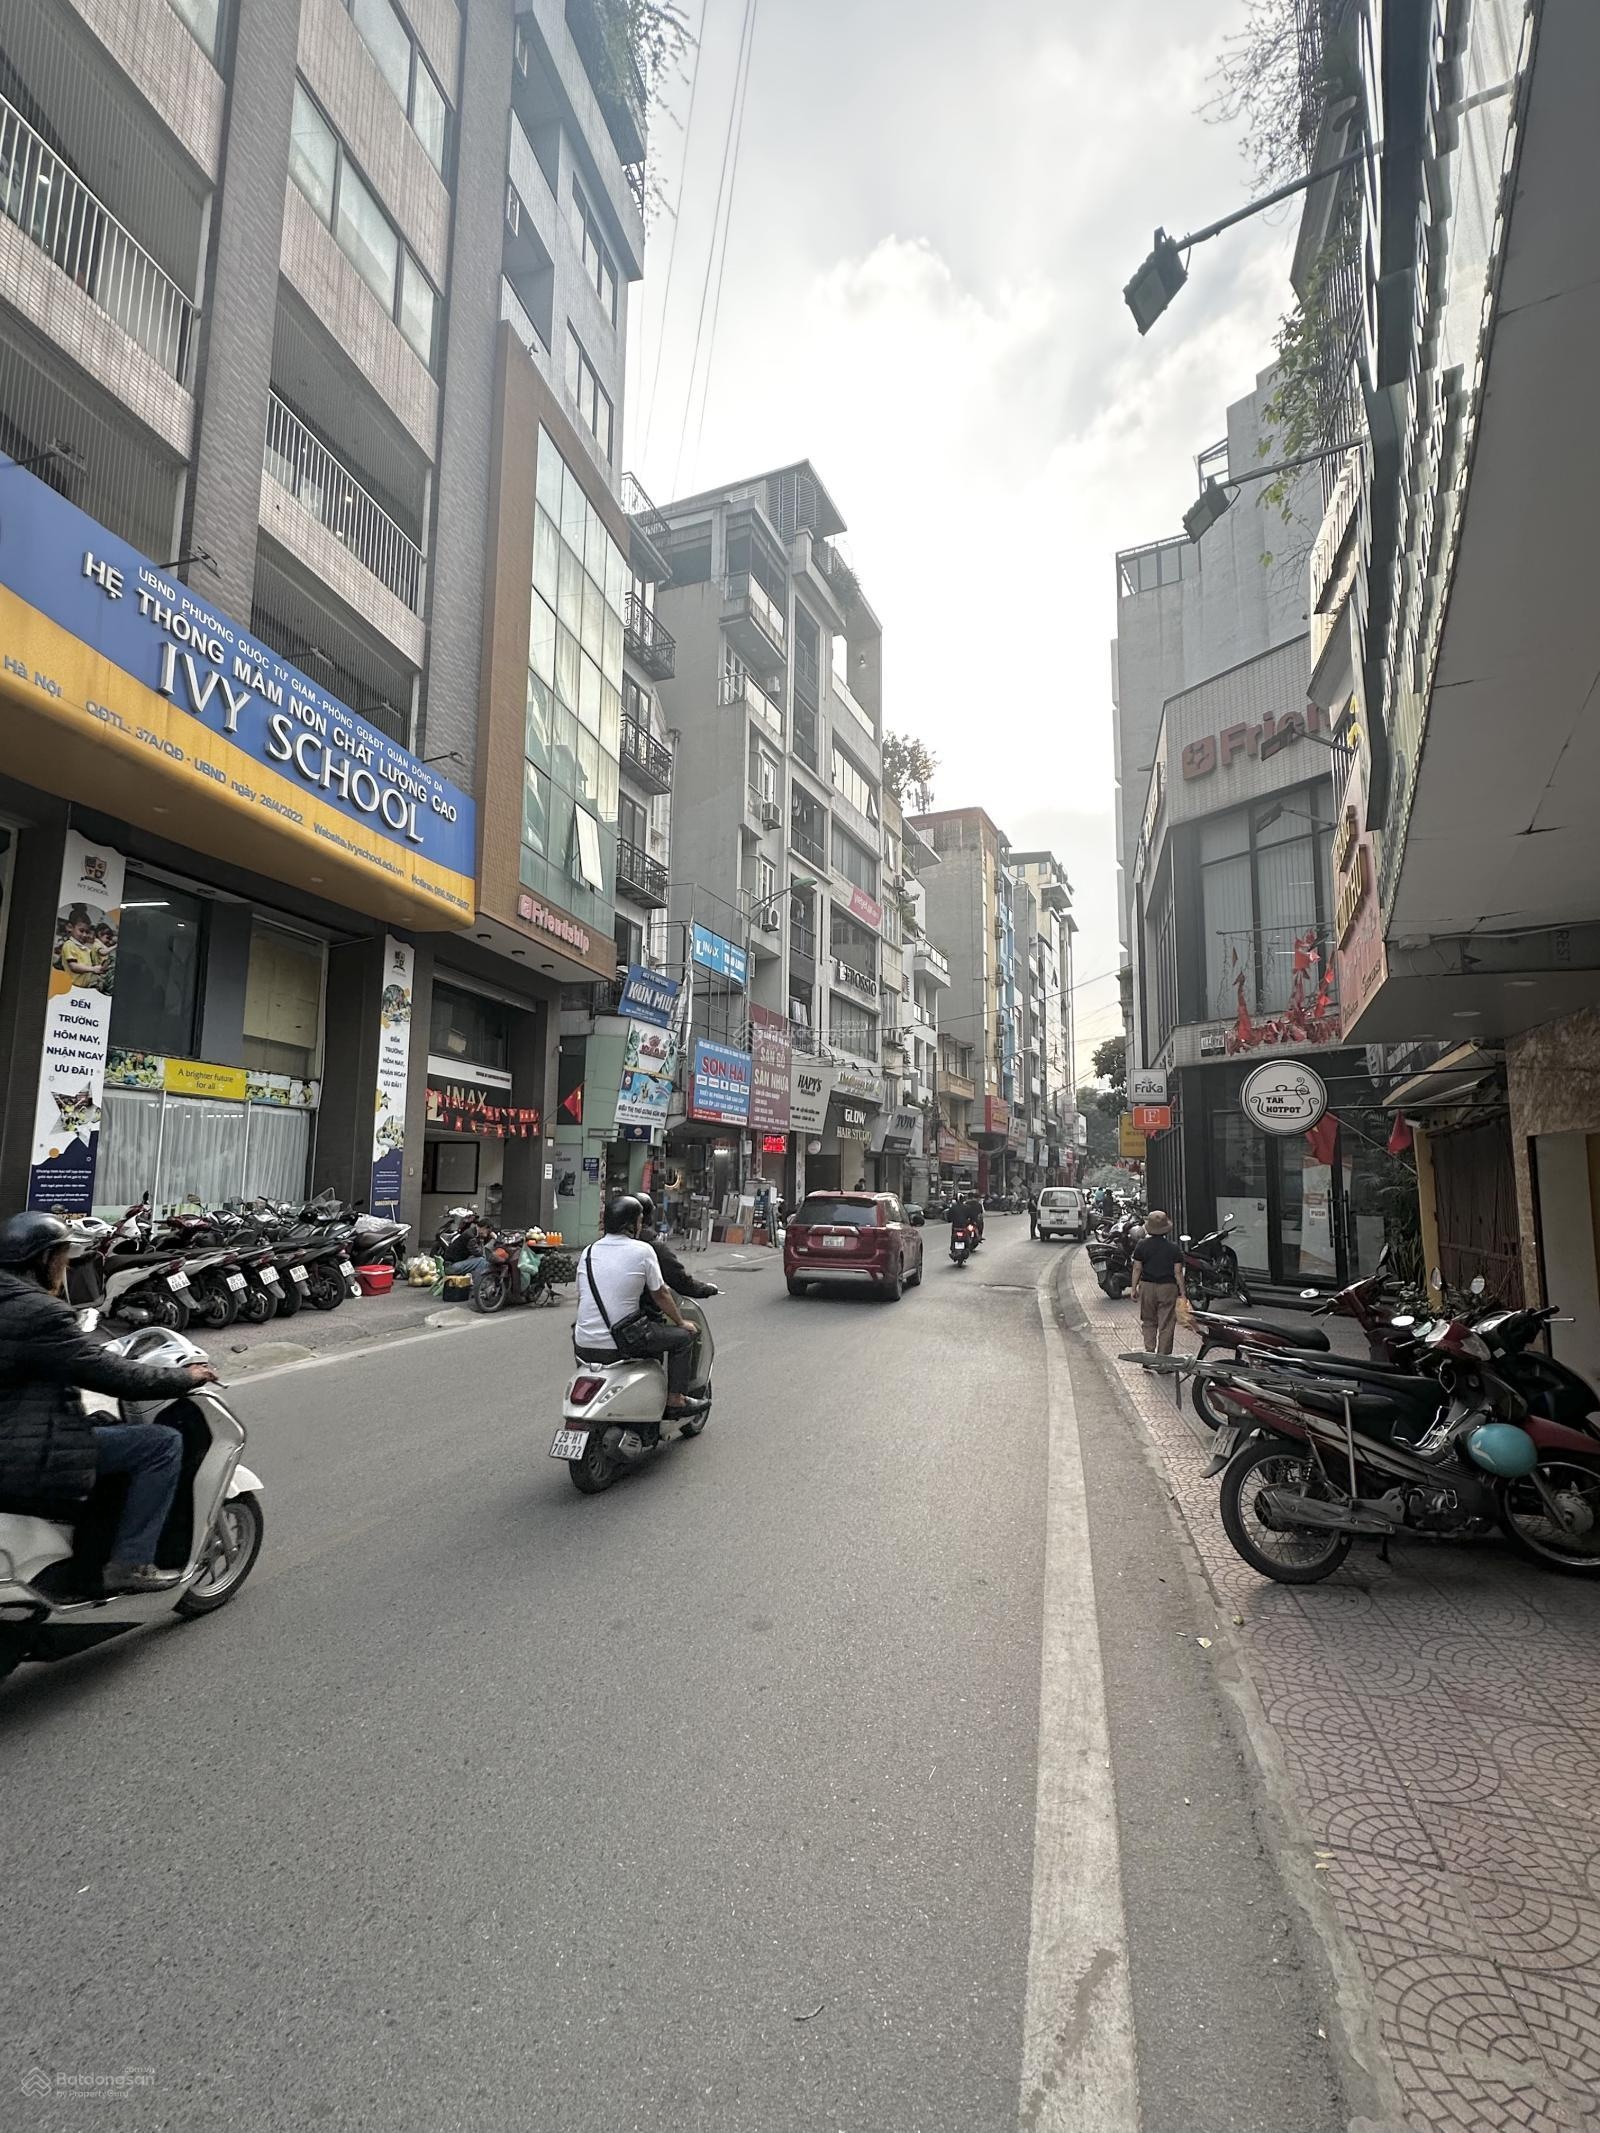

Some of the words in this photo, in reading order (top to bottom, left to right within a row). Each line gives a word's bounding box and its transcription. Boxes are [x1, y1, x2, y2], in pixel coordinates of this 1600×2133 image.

[83, 551, 124, 599] HỆ
[136, 586, 225, 664] THỐNG
[232, 655, 283, 707] MẦM
[289, 697, 327, 736] NON
[333, 725, 375, 767] CHẤT
[378, 760, 428, 803] LƯỢNG
[432, 794, 457, 823] CAO
[139, 566, 176, 602] UBND
[182, 597, 234, 643] PHƯỜNG
[322, 700, 353, 729] PHÒNG
[357, 725, 385, 752] GD&ĐT
[434, 782, 444, 794] ĐA
[4, 656, 28, 680] Hà
[34, 671, 63, 698] Nội
[194, 757, 227, 784] UBND
[231, 779, 257, 802] ngày
[159, 641, 251, 734] IVY
[265, 713, 425, 844] SCHOOL
[530, 899, 590, 956] Friendship
[70, 997, 92, 1010] ĐẾN
[58, 1012, 100, 1028] TRƯỜNG
[52, 1027, 78, 1042] HÔM
[45, 1045, 76, 1060] NHẬN
[77, 1050, 105, 1062] NGAY
[54, 1063, 70, 1075] ƯU
[71, 1063, 88, 1077] ĐÃI
[196, 1080, 207, 1090] for
[207, 1082, 216, 1090] all
[1265, 1096, 1284, 1104] TAK
[844, 1108, 867, 1126] GLOW
[836, 1126, 852, 1139] HAIR
